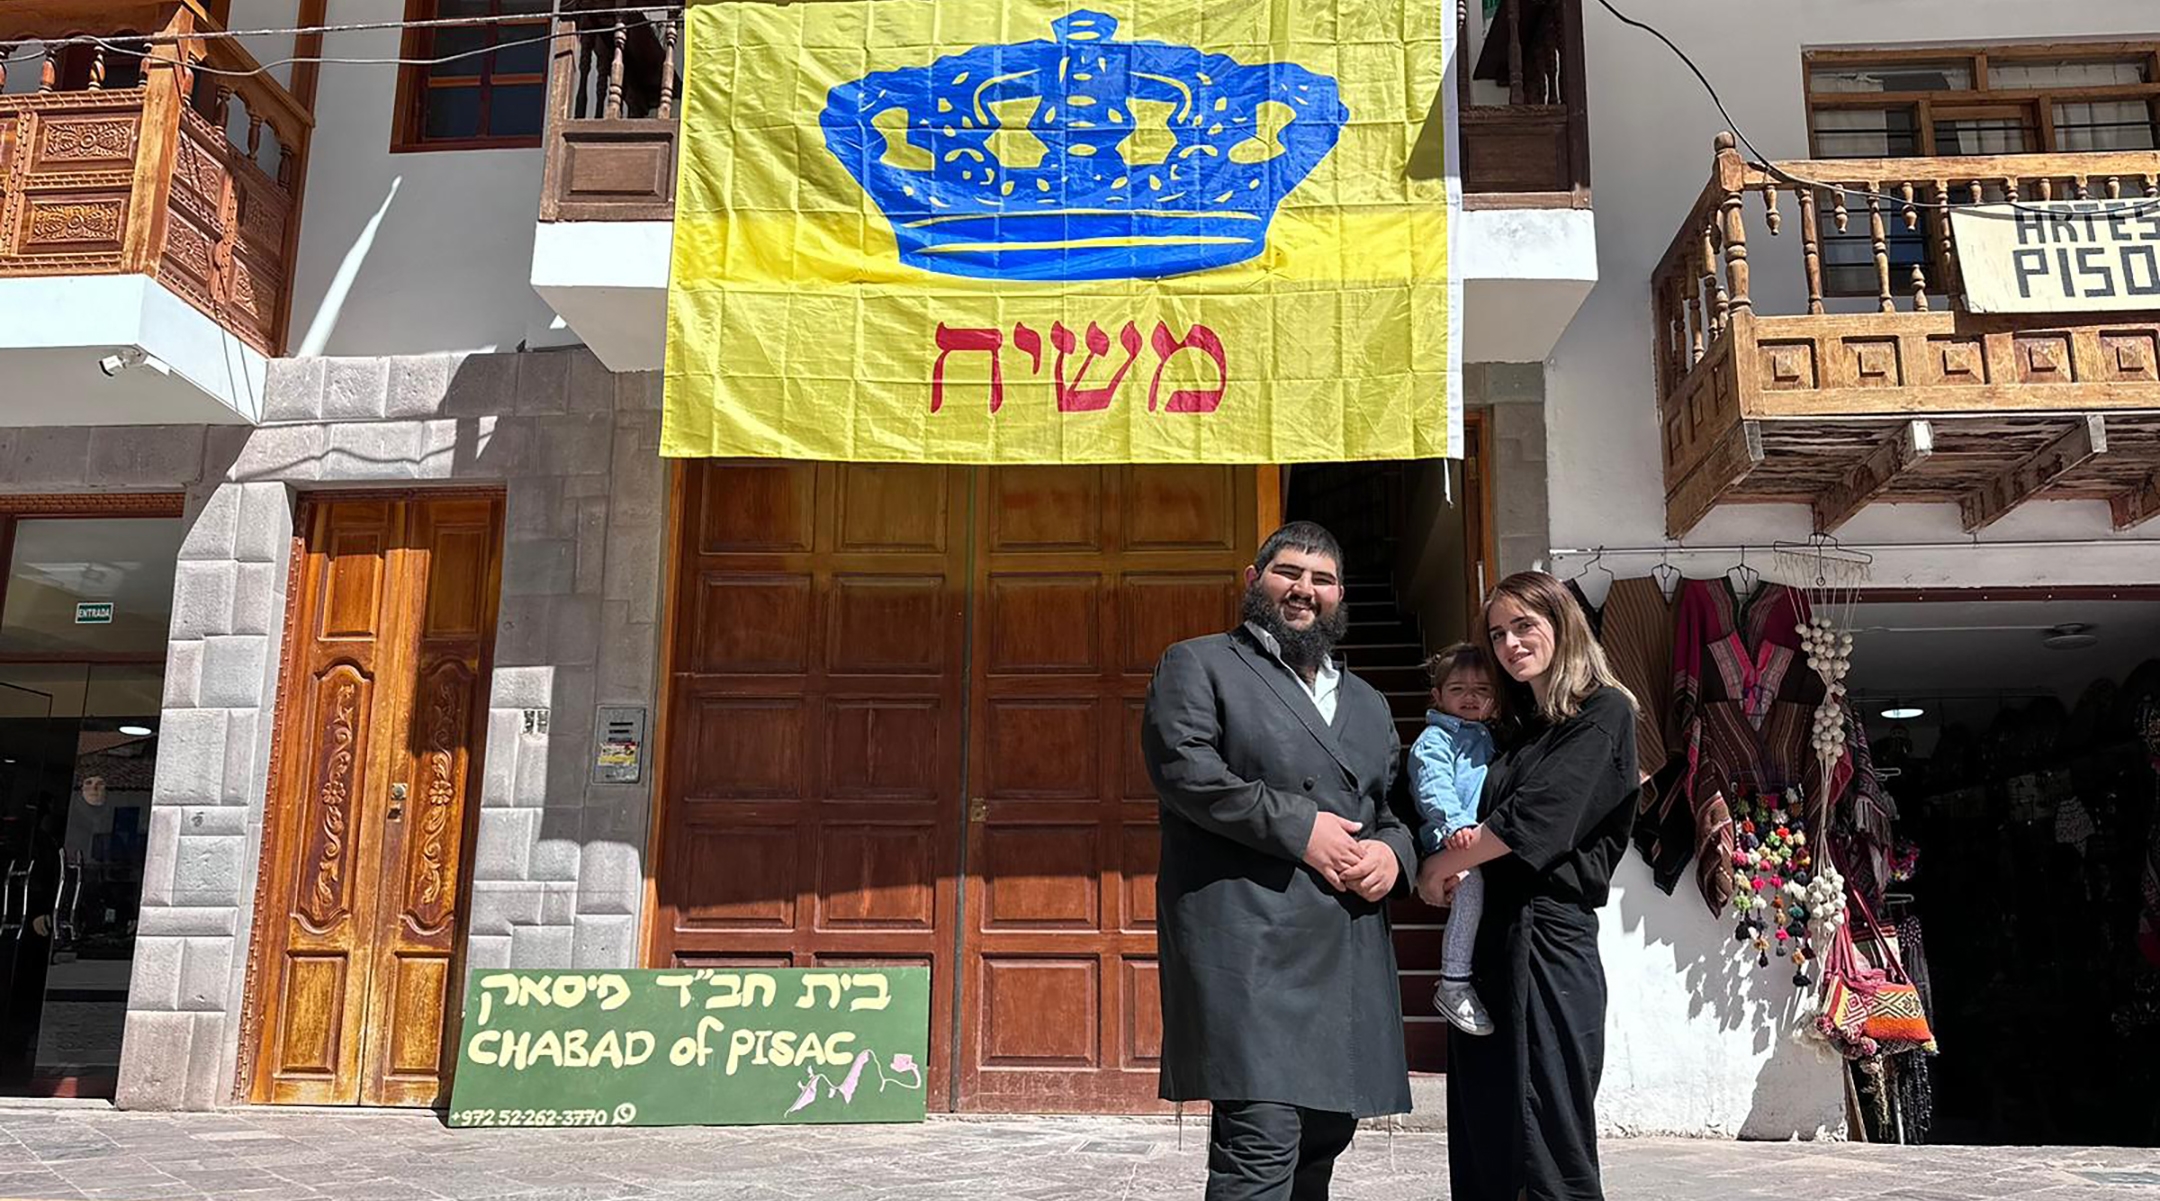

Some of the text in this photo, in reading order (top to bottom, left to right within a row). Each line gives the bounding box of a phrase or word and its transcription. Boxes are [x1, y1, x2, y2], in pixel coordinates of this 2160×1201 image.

[2013, 202, 2160, 245] ARTES
[2013, 245, 2160, 298] PISO
[930, 320, 1227, 414] משיח
[478, 973, 631, 1026] פיסאק
[795, 973, 892, 1011] בית
[468, 1016, 856, 1076] CHABAD of PISAC
[451, 1109, 608, 1127] +972 52-262-3770
